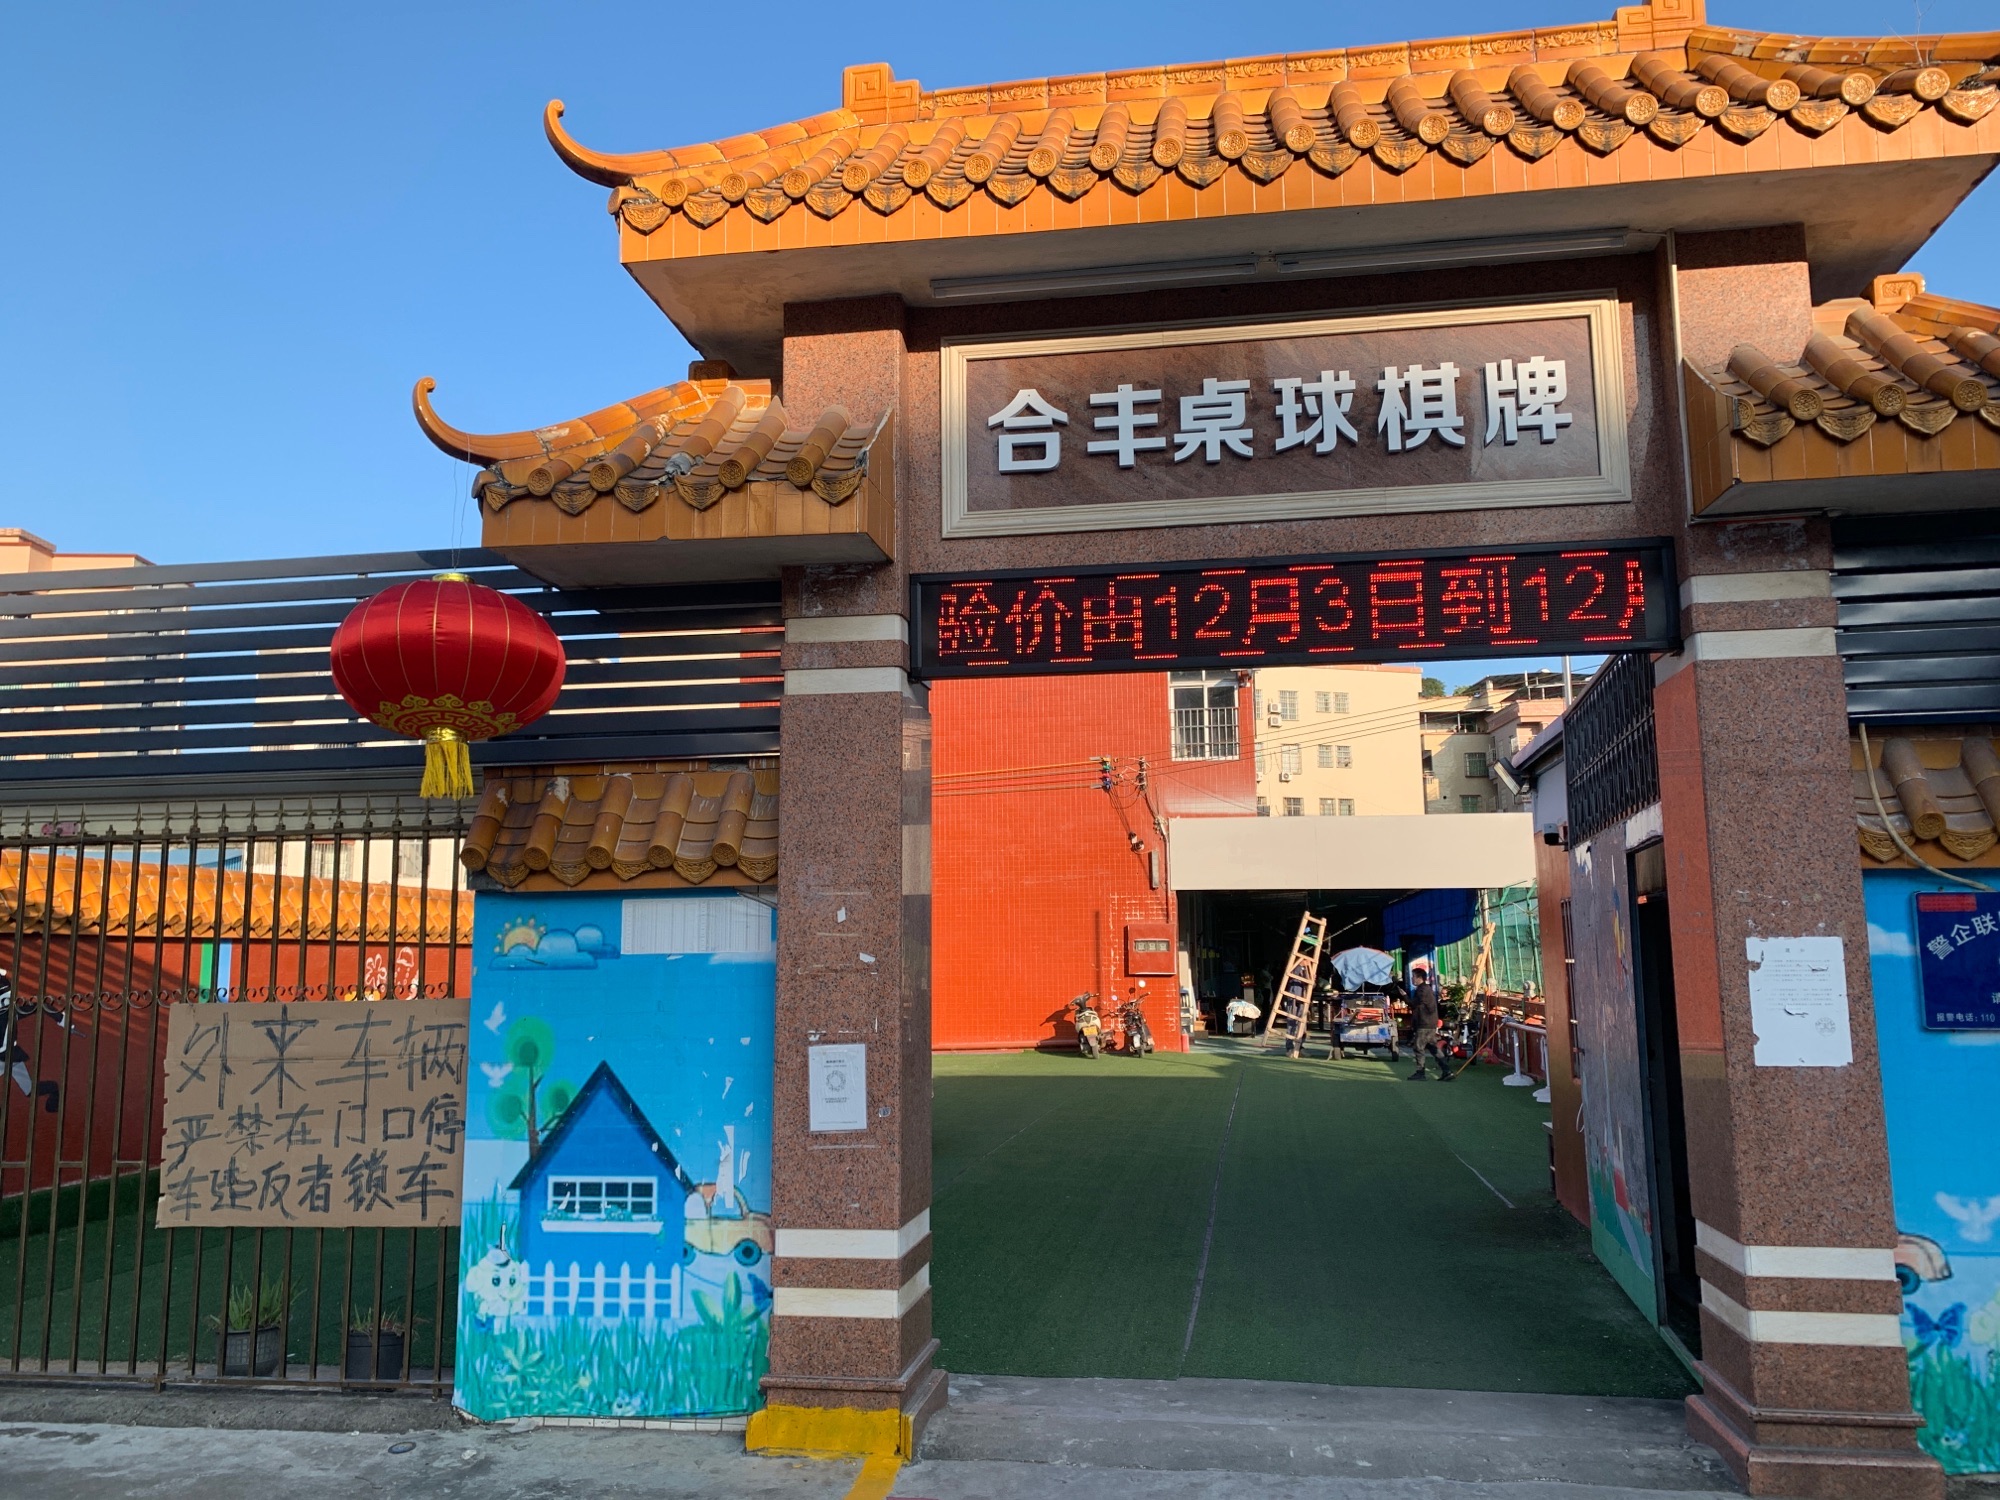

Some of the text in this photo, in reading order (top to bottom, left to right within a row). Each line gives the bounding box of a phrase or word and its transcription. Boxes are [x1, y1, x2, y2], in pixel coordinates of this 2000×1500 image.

[987, 355, 1574, 474] 合丰桌球棋牌
[1926, 911, 2000, 960] 警企联
[176, 1004, 466, 1110] 外来车辆
[166, 1093, 466, 1176] 严禁在门口停
